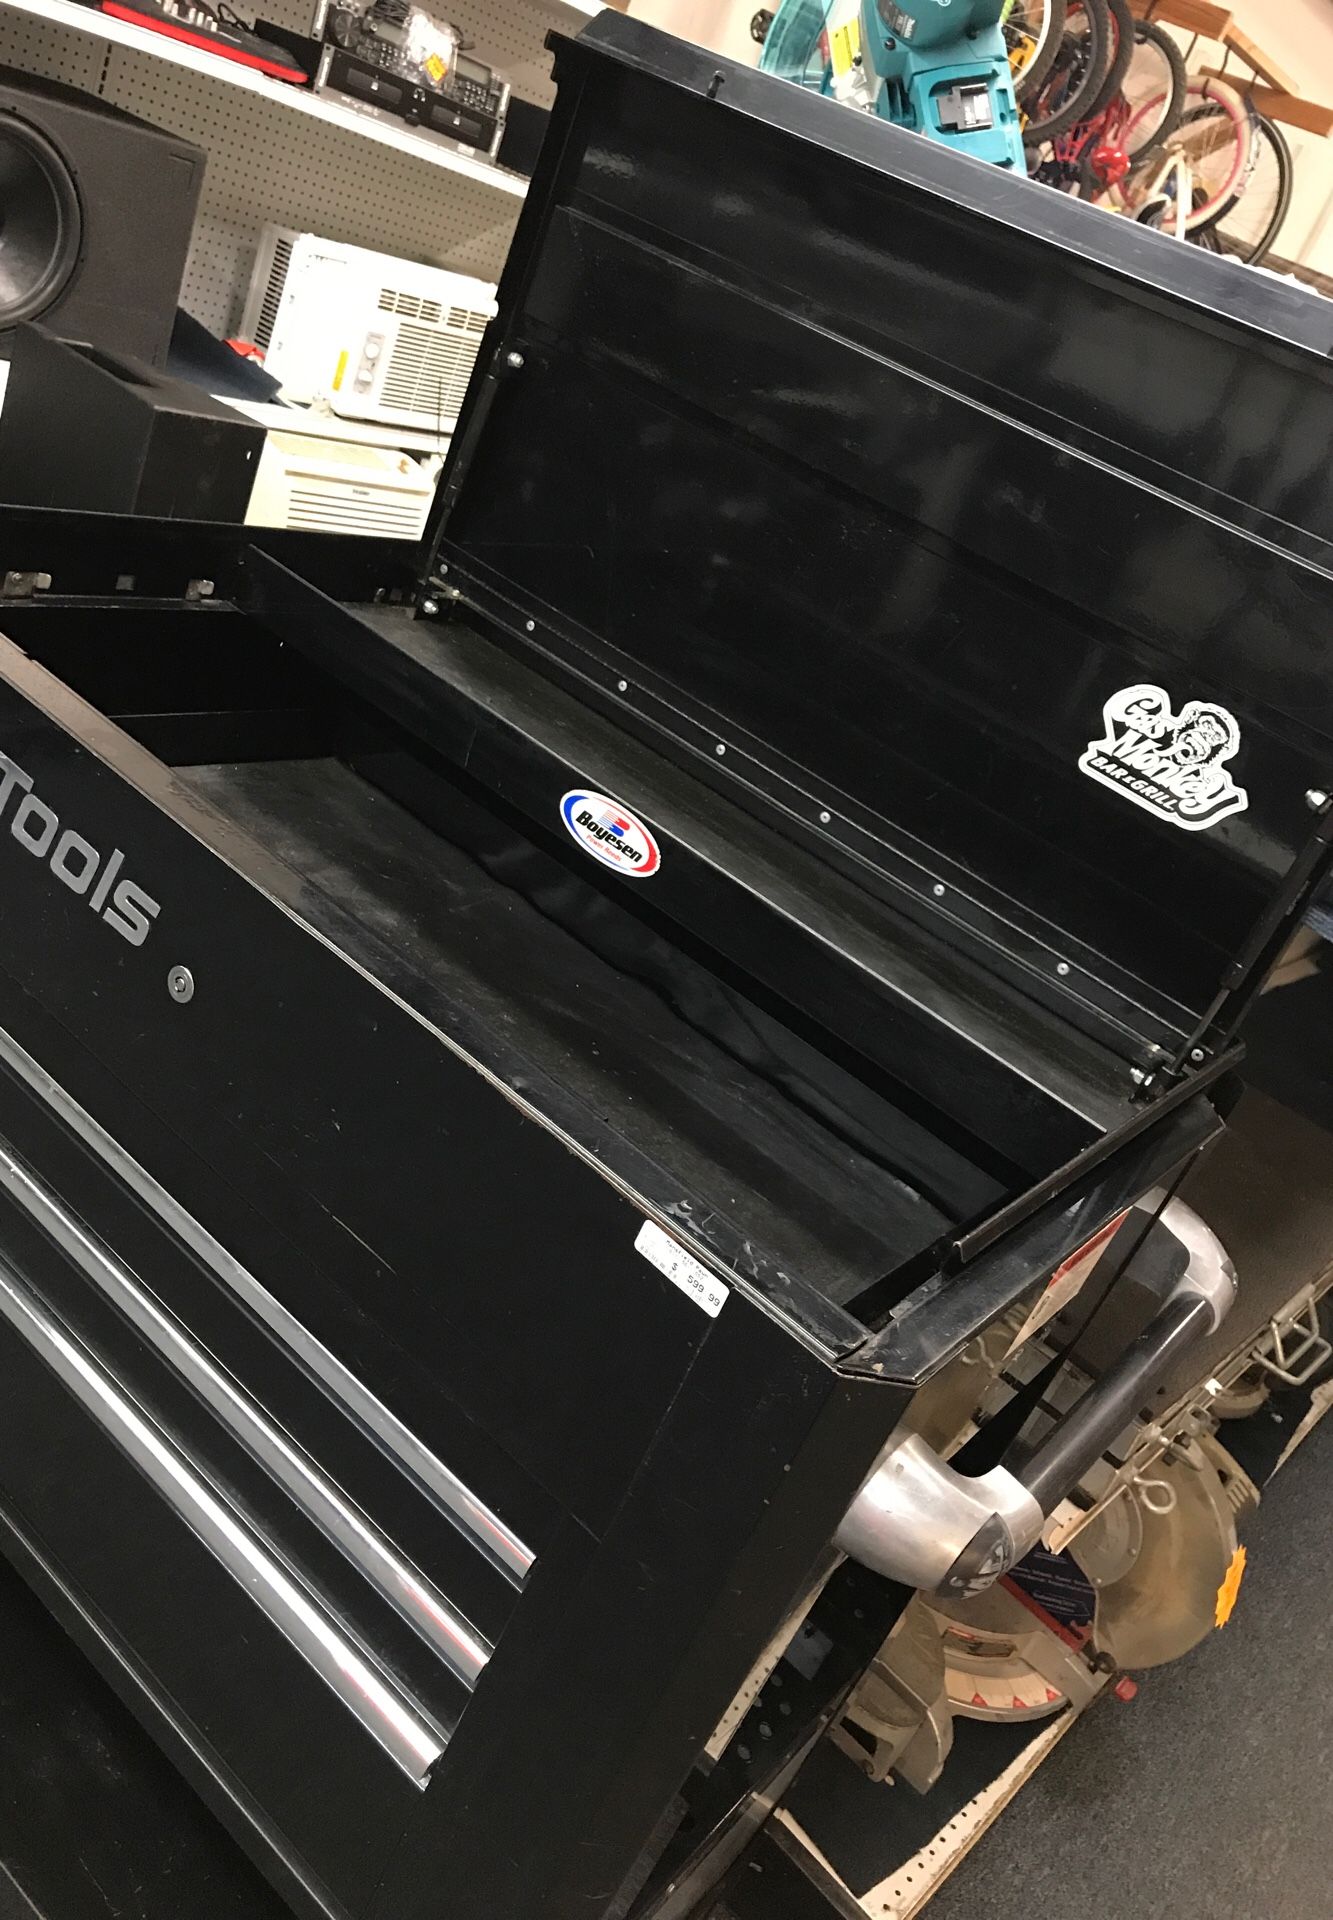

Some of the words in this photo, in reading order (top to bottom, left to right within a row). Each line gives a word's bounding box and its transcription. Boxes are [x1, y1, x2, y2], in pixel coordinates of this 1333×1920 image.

[1089, 756, 1128, 780] BAR
[1130, 778, 1178, 812] GRILL
[1096, 728, 1240, 816] Monkey
[0, 751, 162, 947] Tools
[575, 810, 643, 863] Boyesen
[586, 834, 604, 850] Power
[605, 846, 623, 862] Reeds
